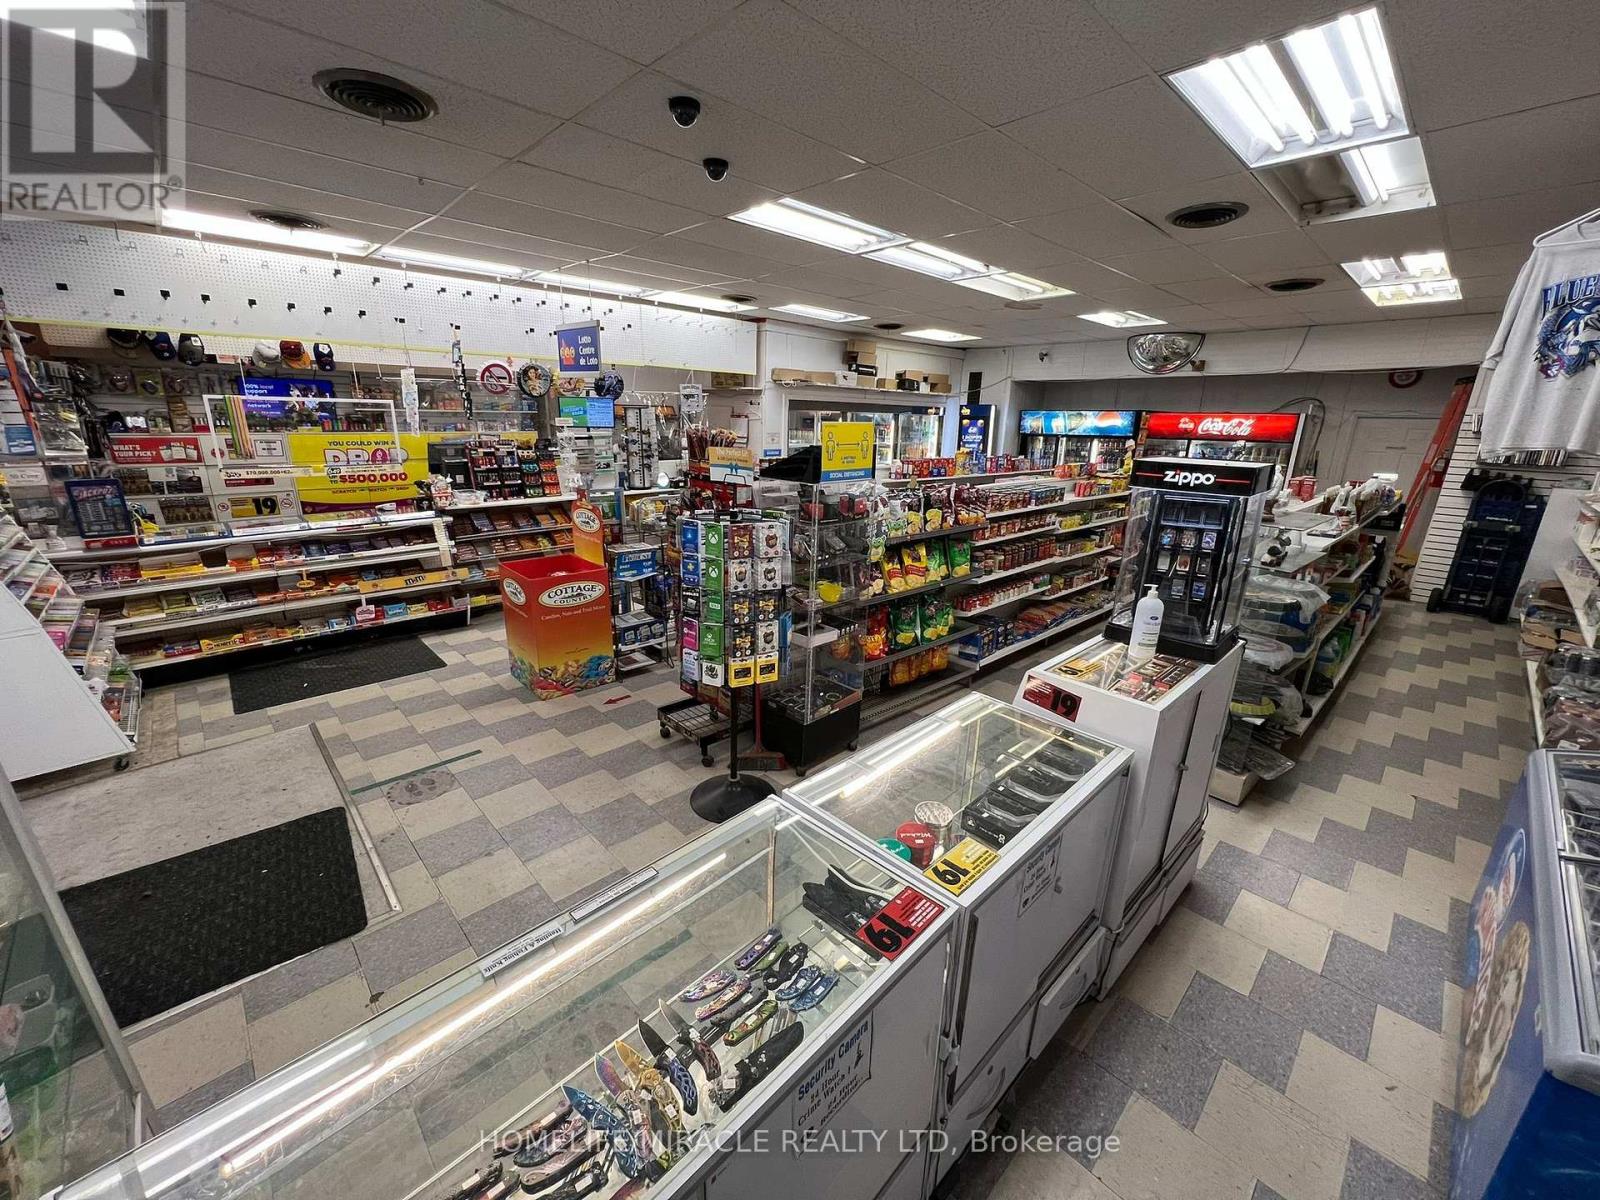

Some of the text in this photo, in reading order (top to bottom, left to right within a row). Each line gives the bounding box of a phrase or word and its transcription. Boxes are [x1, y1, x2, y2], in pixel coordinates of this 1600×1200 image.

[578, 336, 592, 344] Lotto
[579, 346, 595, 355] Centre
[1197, 416, 1256, 436] Coca-Cola
[339, 472, 408, 484] $500,000
[547, 584, 597, 599] COTTAGE
[553, 594, 593, 605] COUNTRY
[1050, 688, 1078, 718] 19
[931, 858, 972, 886] 19
[864, 912, 916, 953] 19
[798, 1020, 869, 1102] Security Camera
[822, 1069, 840, 1091] Hour
[798, 1099, 822, 1127] Crime
[823, 1073, 846, 1099] Watch
